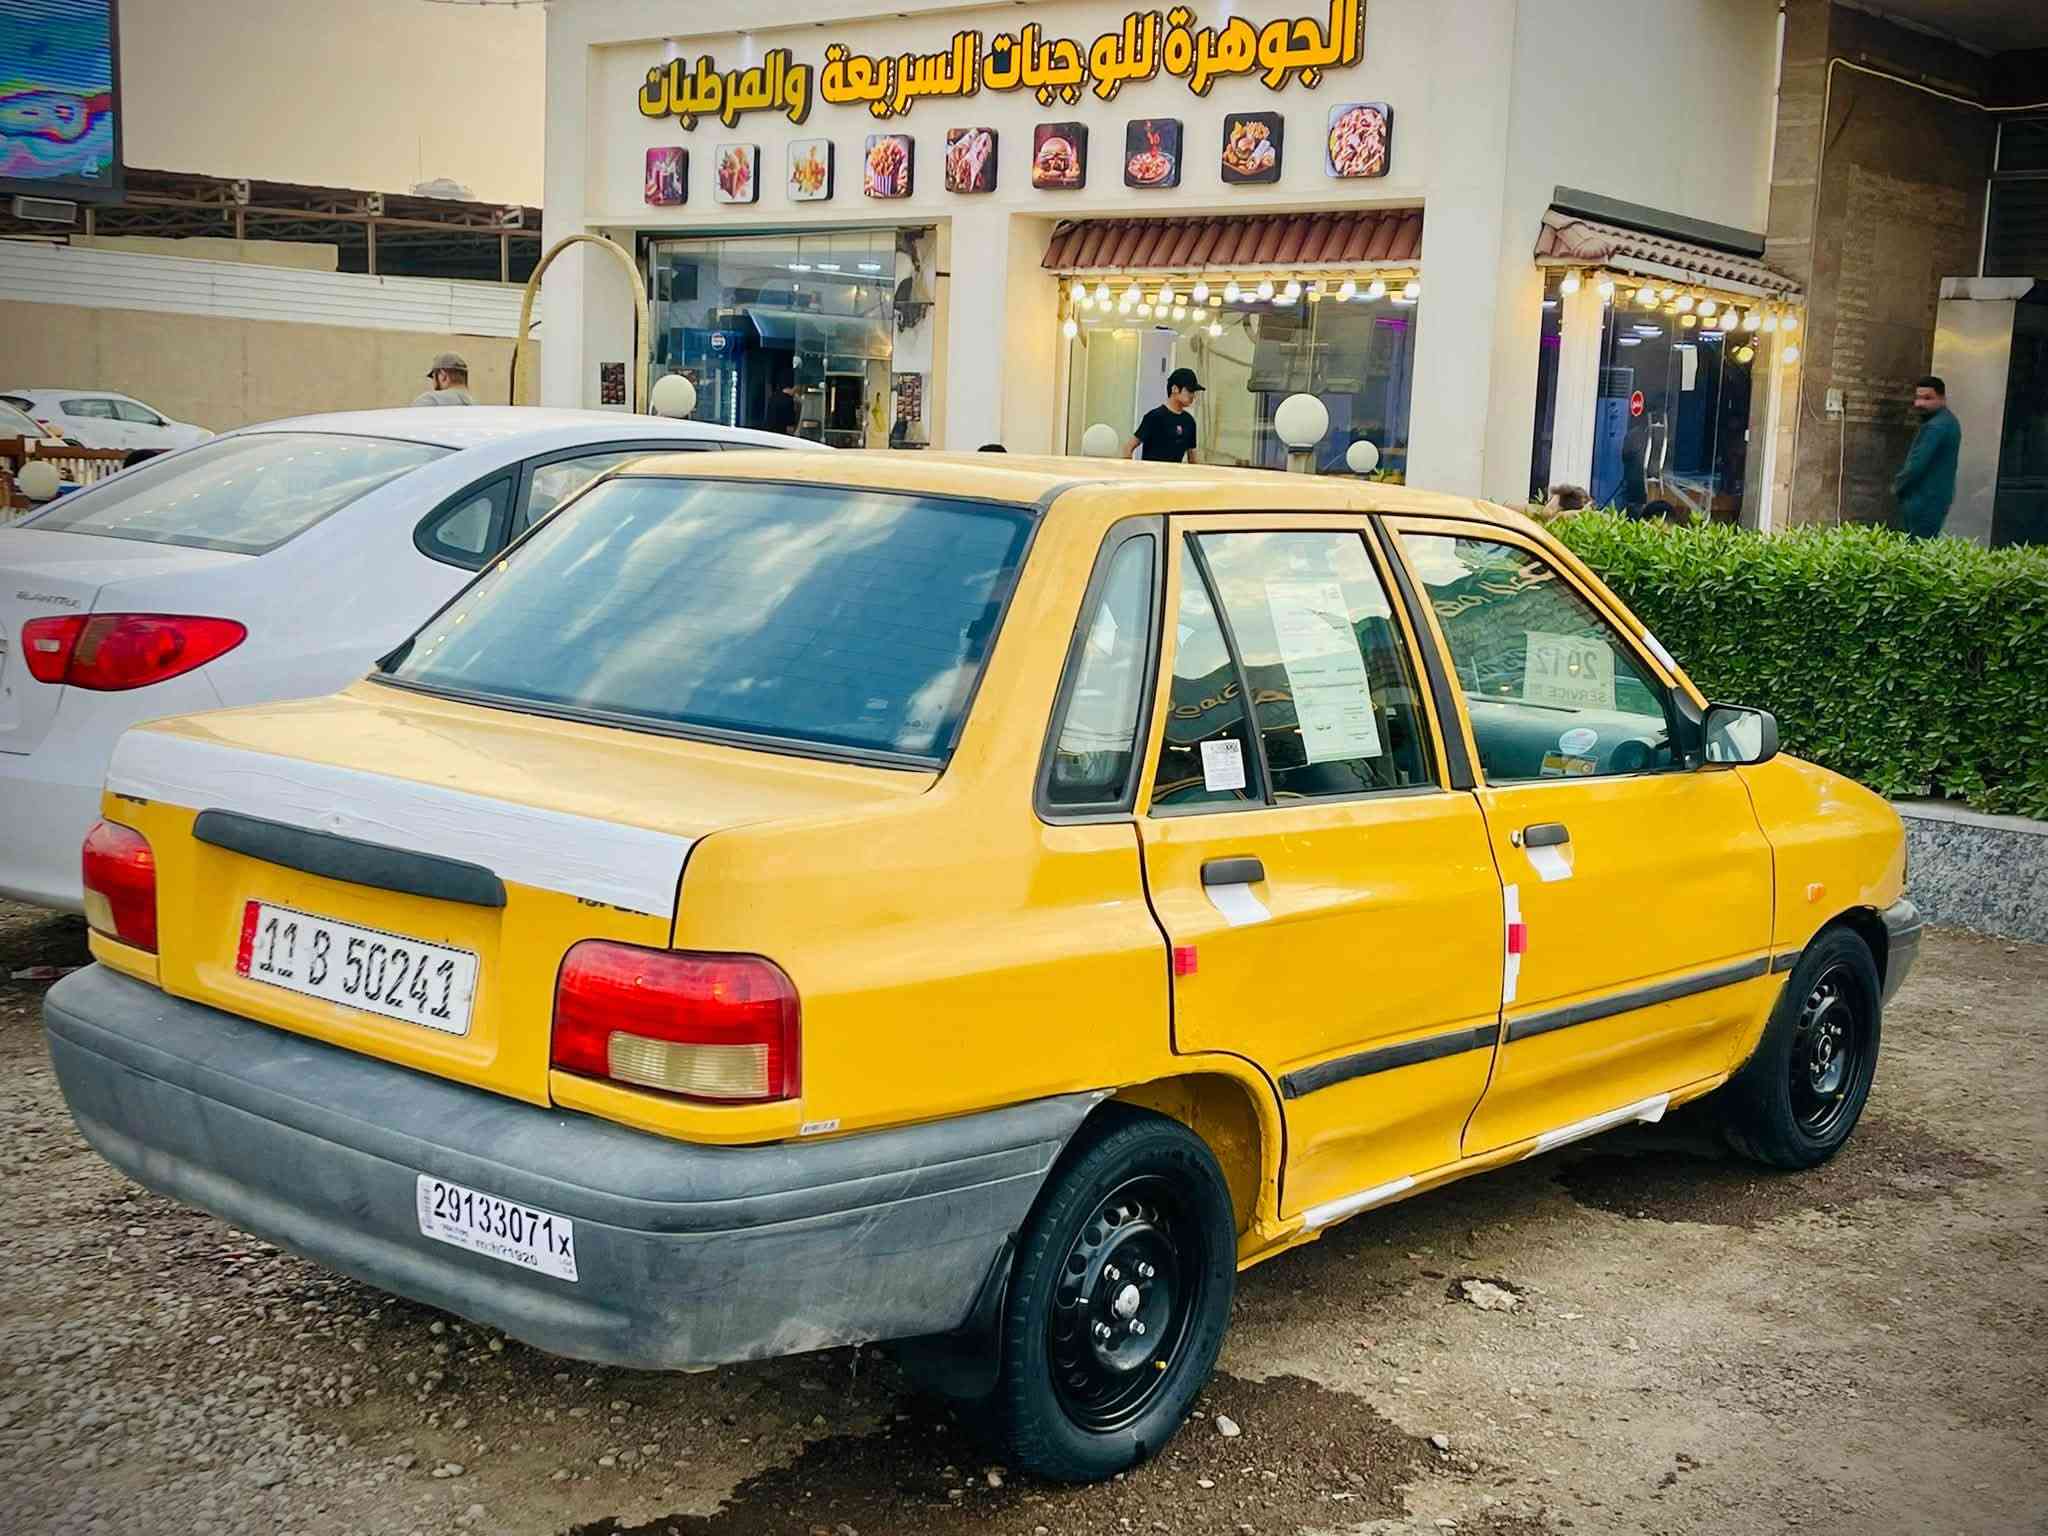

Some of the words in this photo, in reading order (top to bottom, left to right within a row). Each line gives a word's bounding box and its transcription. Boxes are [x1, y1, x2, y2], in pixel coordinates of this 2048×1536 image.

[639, 48, 813, 131] والمرطبات
[820, 30, 983, 119] السريعة
[983, 10, 1163, 107] للوجبات
[1163, 0, 1366, 97] الجوهرة
[259, 917, 298, 978] 11
[342, 936, 456, 1020] 50241
